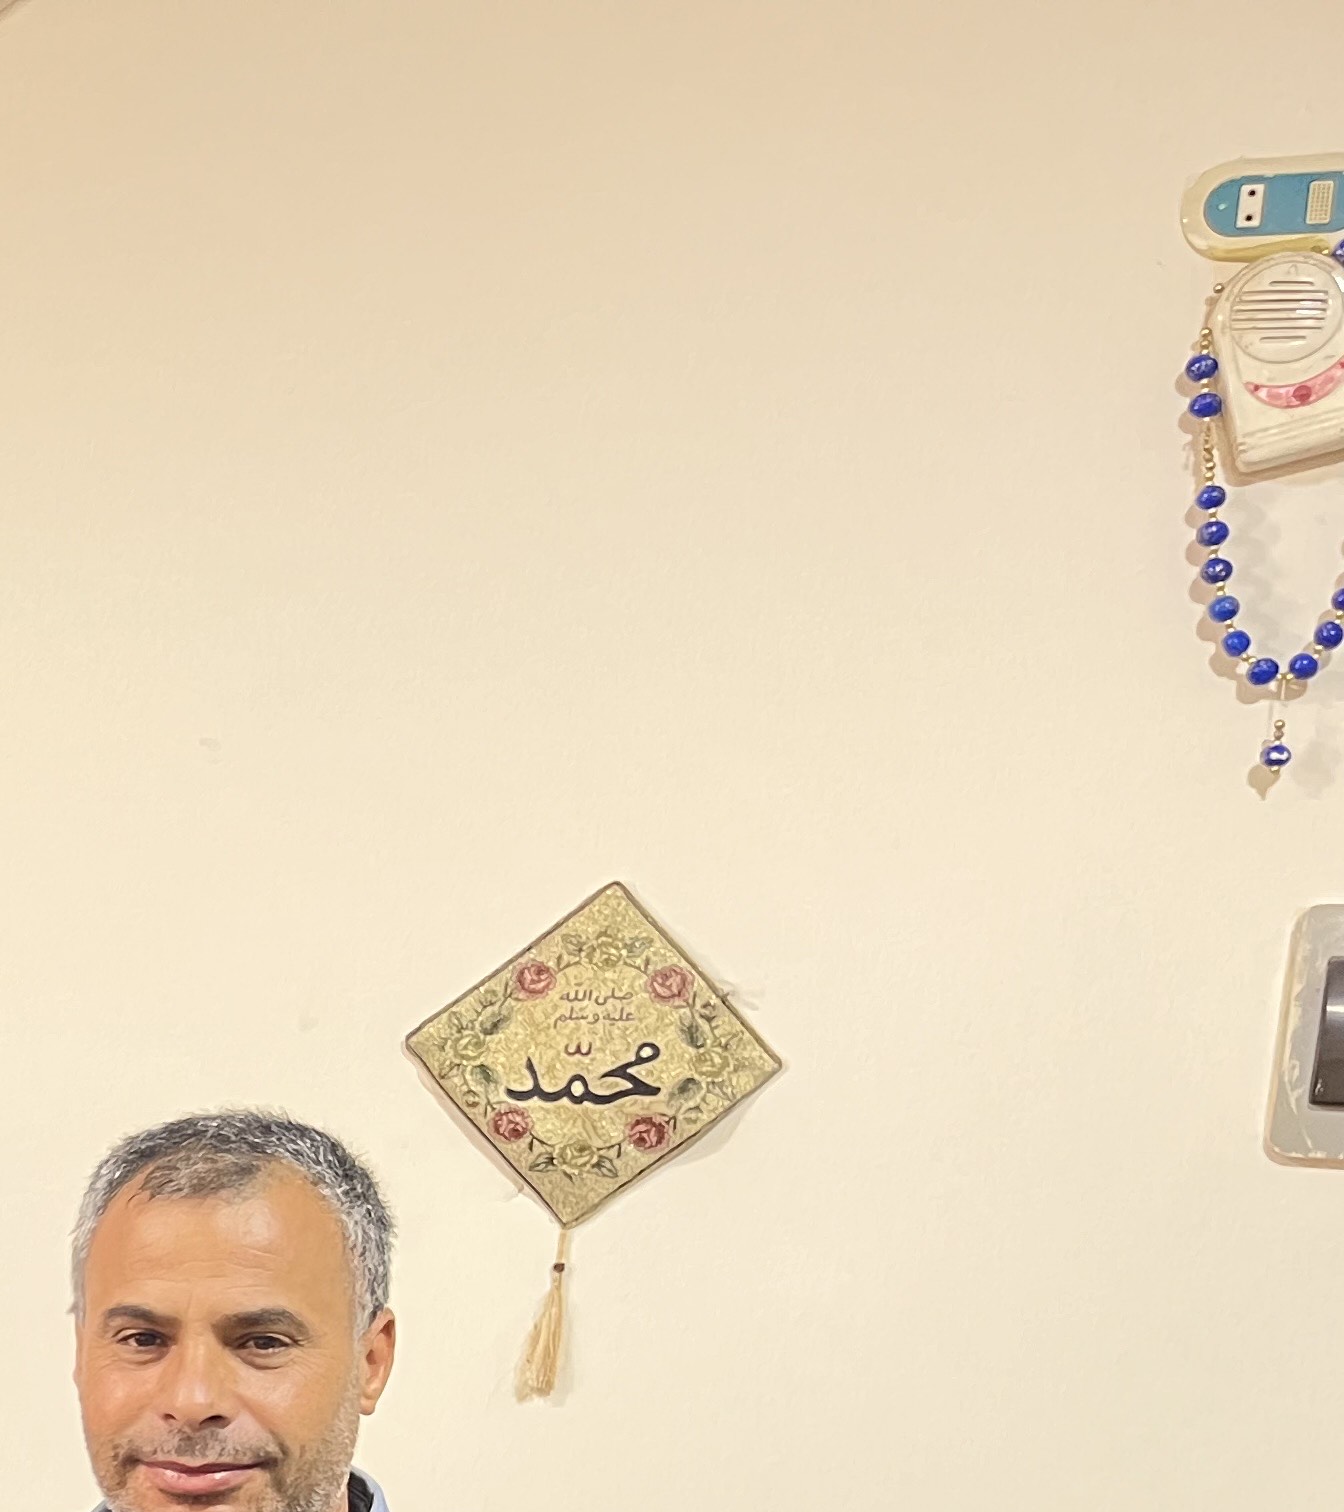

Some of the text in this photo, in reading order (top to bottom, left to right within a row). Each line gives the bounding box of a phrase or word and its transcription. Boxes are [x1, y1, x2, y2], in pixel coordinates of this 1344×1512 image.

[559, 982, 593, 1003] الله
[602, 1007, 636, 1026] عليه
[505, 1041, 662, 1106] محمد
